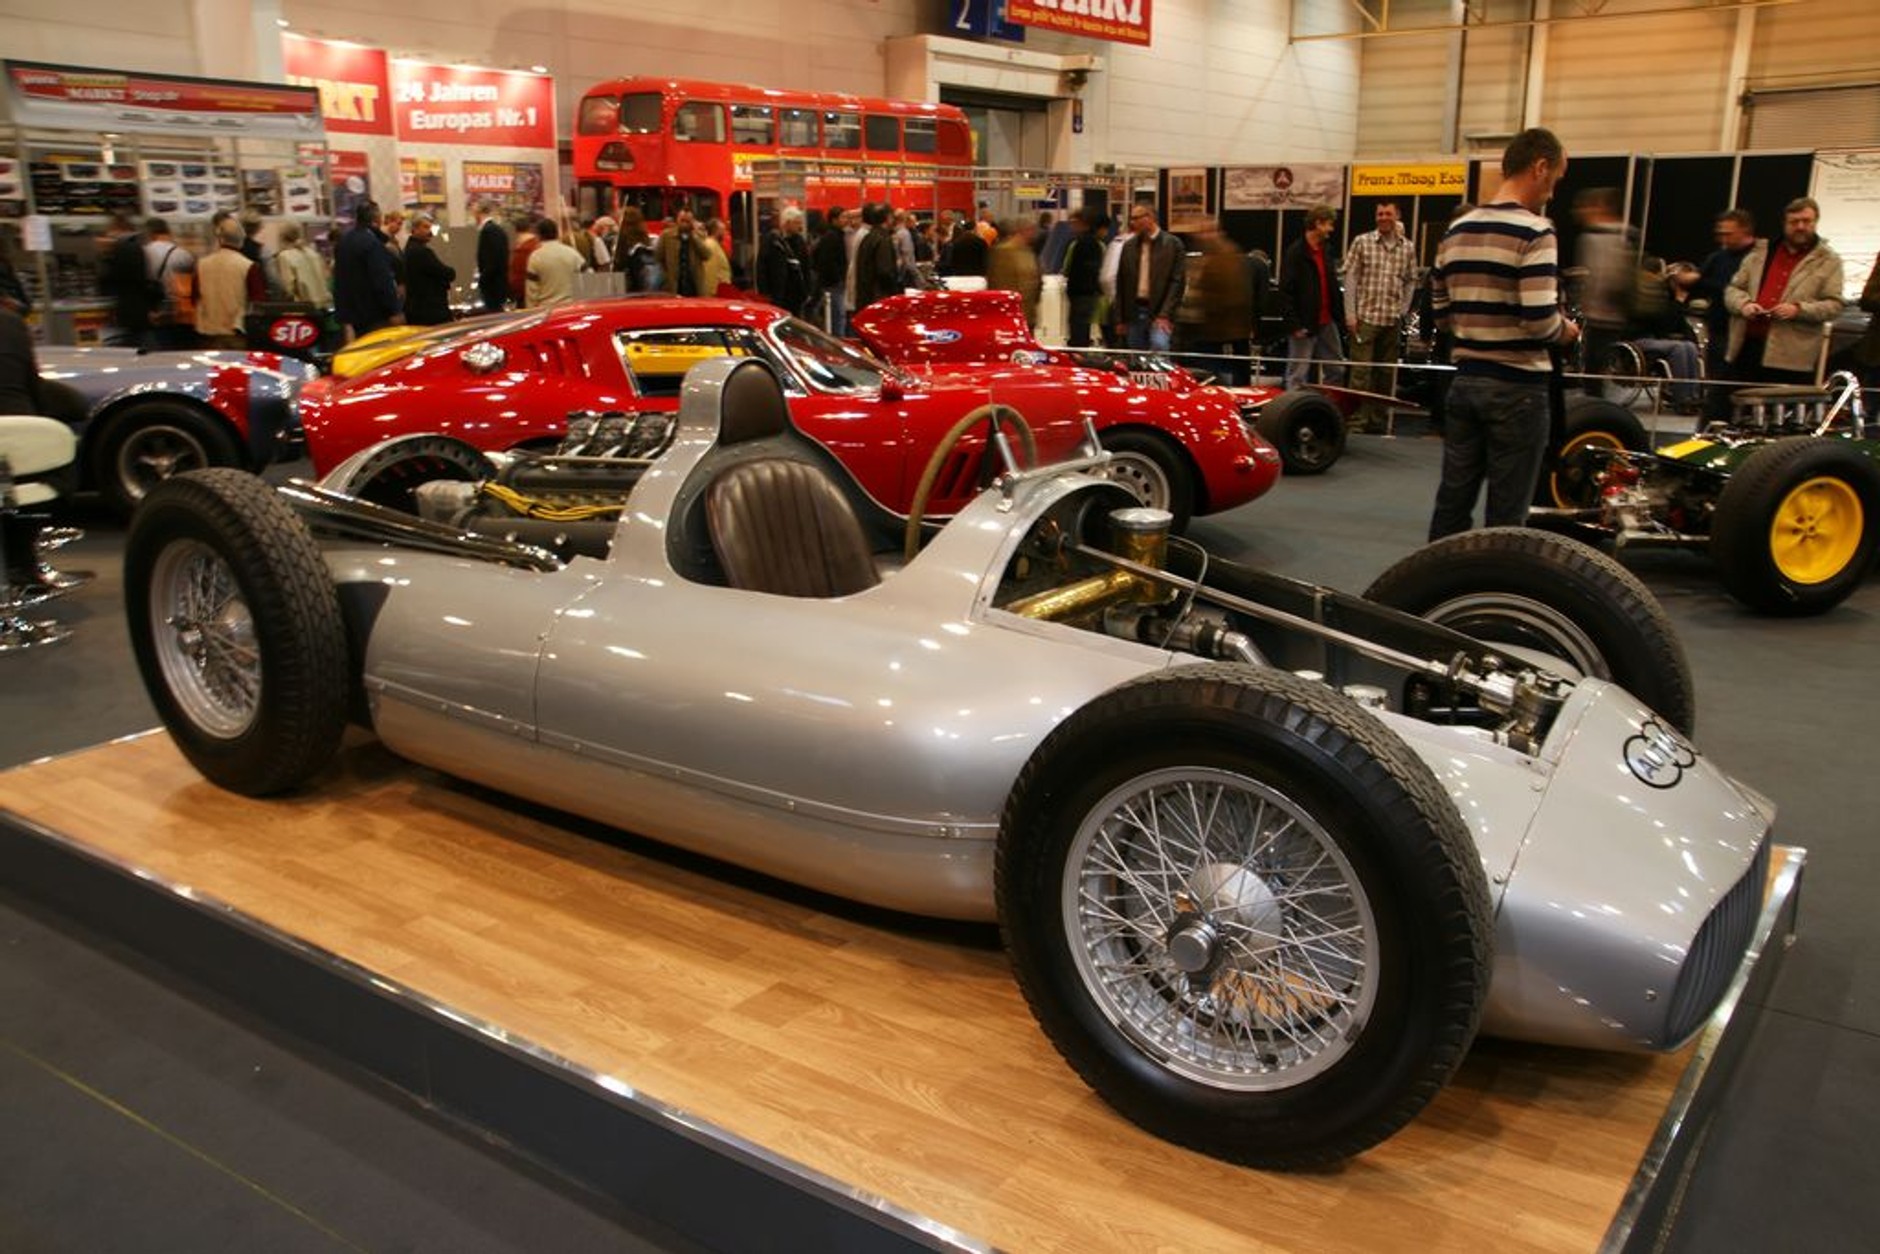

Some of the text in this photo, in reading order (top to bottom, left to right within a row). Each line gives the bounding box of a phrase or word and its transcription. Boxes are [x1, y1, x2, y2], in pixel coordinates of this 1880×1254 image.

[397, 81, 498, 102] 24 Jahren
[410, 109, 492, 133] Europas
[467, 174, 515, 189] MARKT
[1358, 173, 1395, 185] Franz
[272, 321, 312, 342] STP
